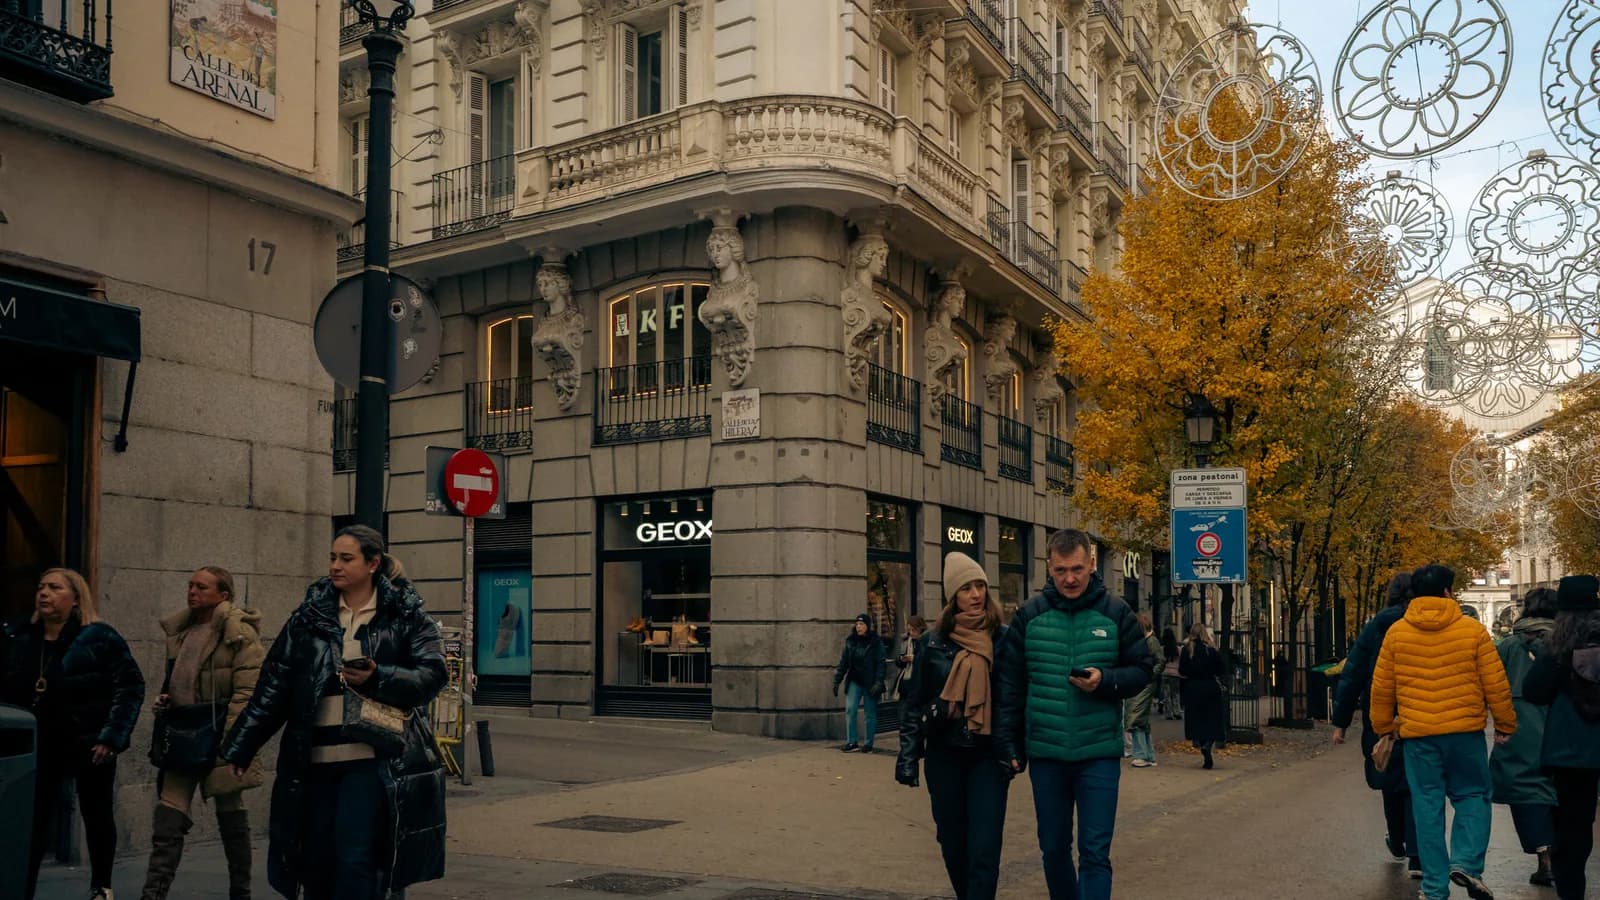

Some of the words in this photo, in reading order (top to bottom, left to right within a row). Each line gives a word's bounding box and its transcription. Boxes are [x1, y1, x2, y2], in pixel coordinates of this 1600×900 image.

[183, 45, 238, 79] CALLE
[241, 69, 265, 88] DEL
[181, 64, 267, 112] ARENAL
[248, 237, 276, 275] 17
[1200, 472, 1239, 482] peatonal
[636, 519, 712, 543] GEOX
[948, 526, 974, 544] GEOX
[494, 578, 520, 586] GEOX
